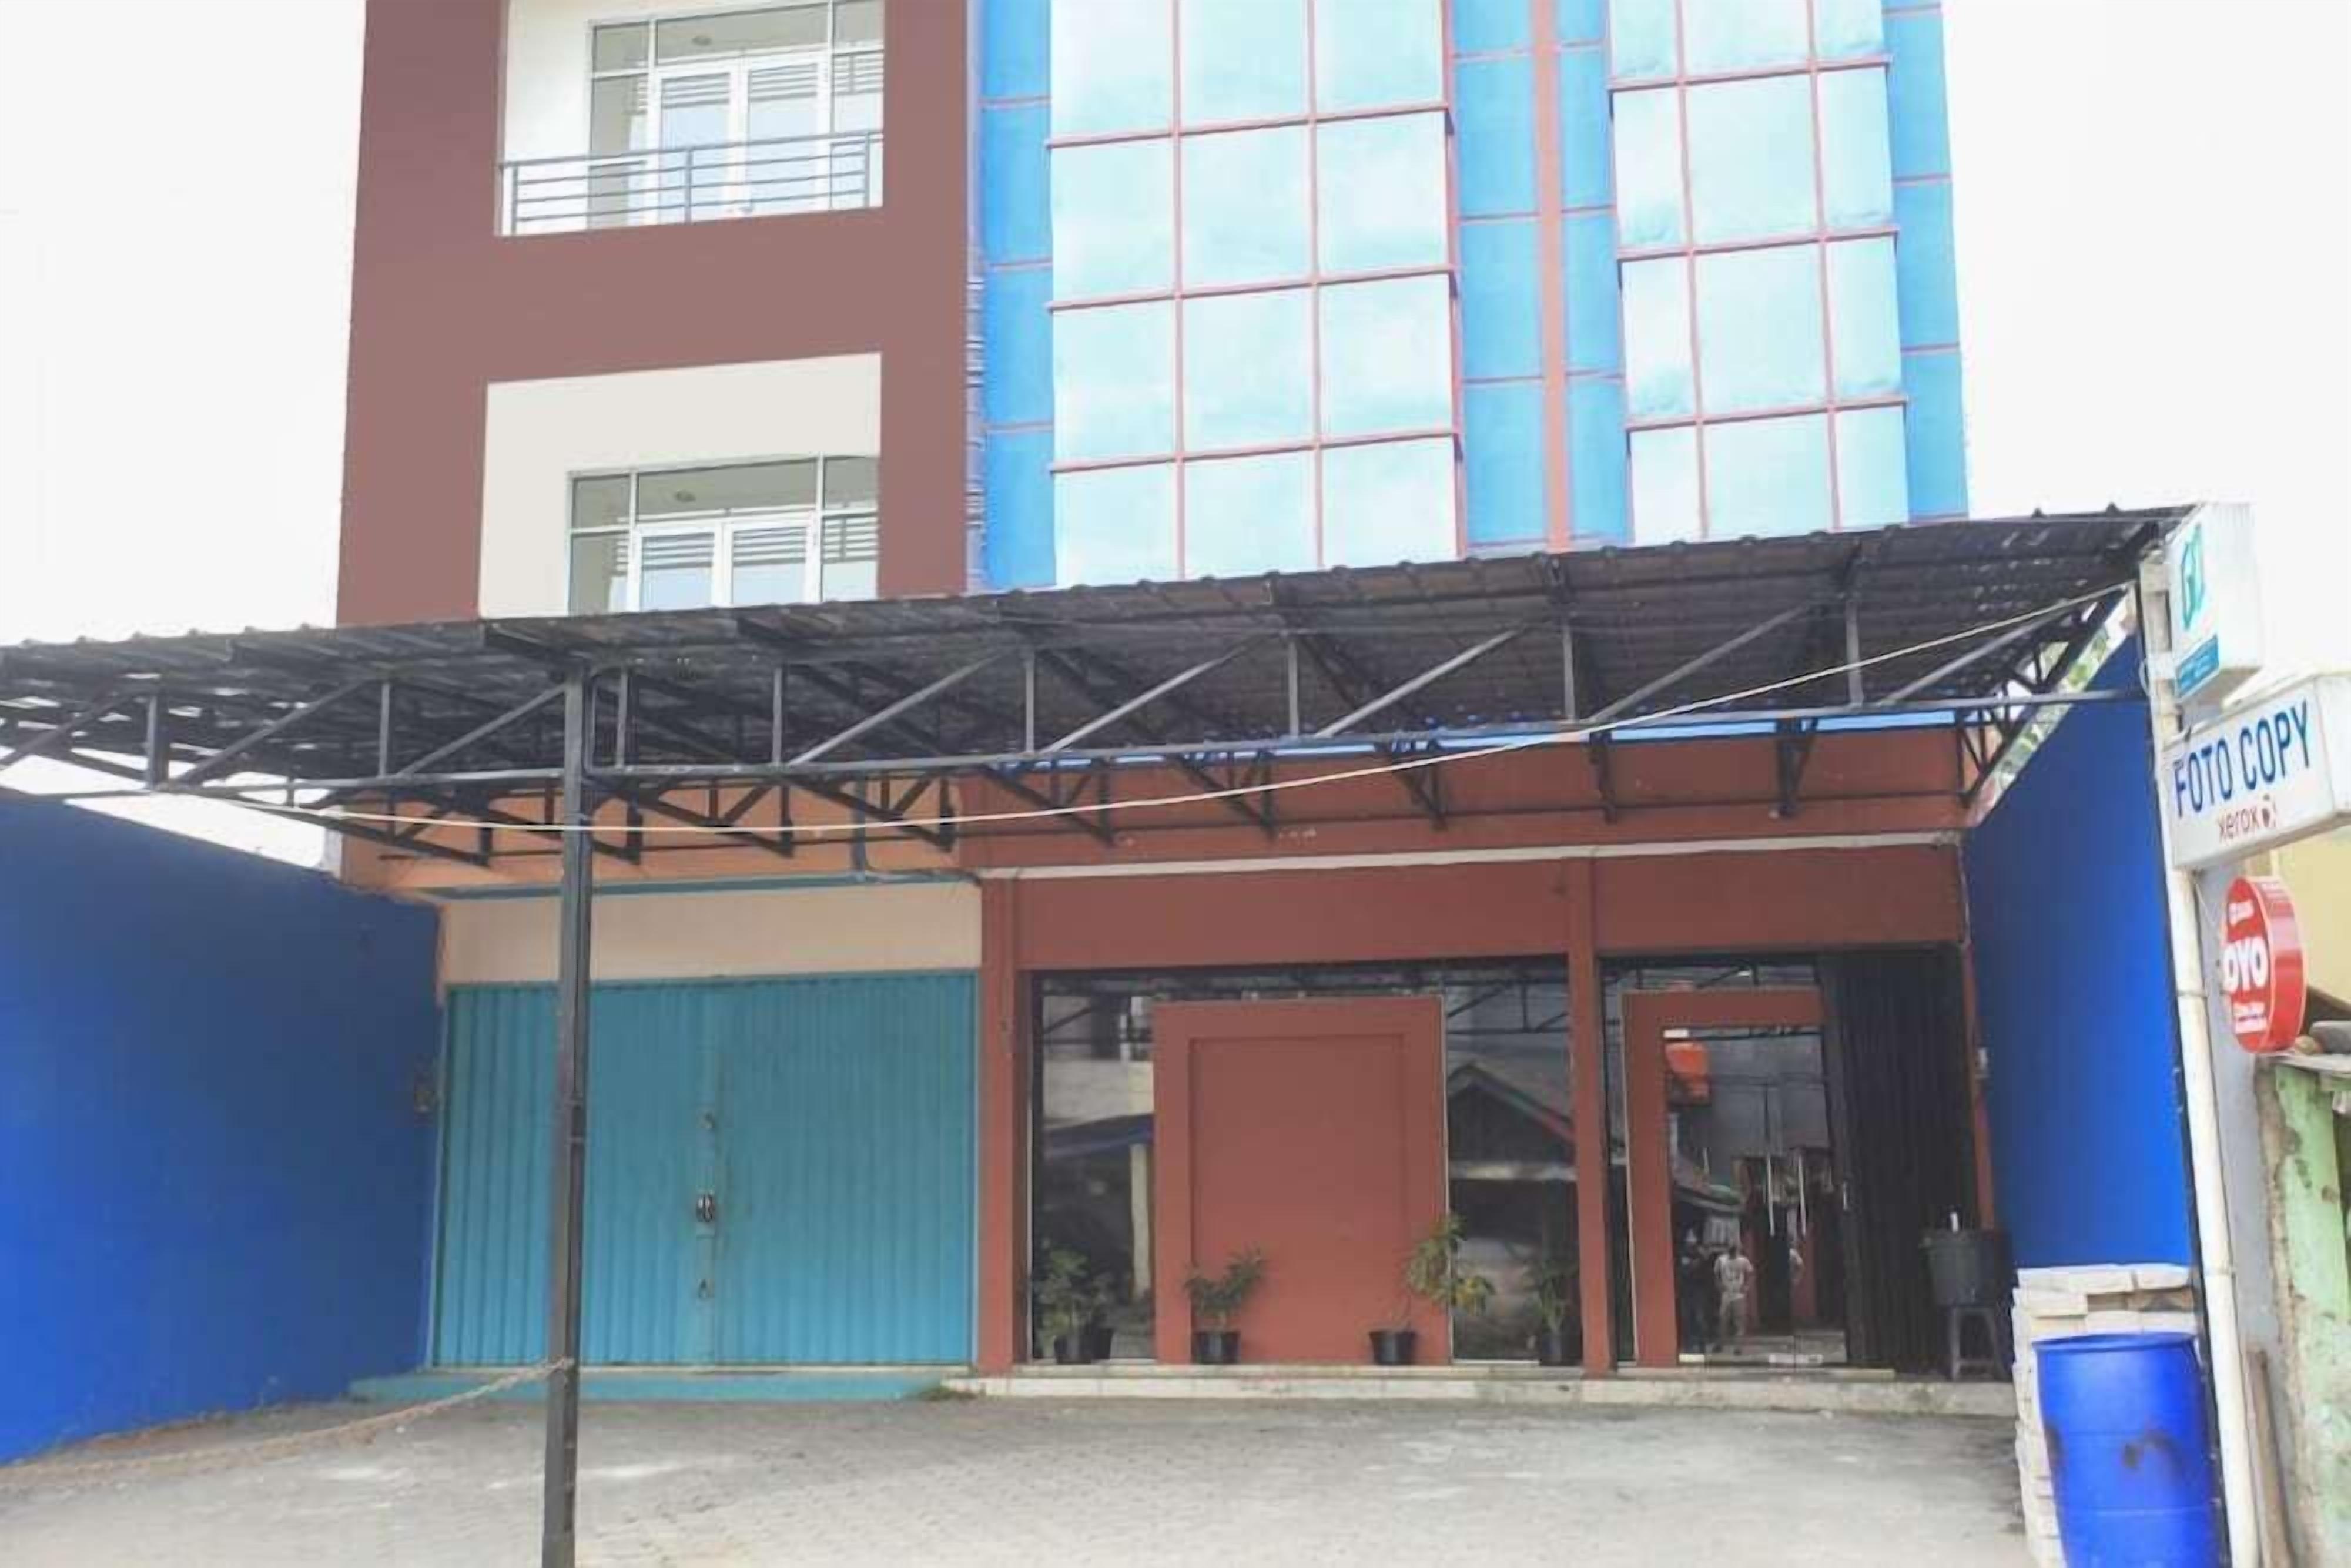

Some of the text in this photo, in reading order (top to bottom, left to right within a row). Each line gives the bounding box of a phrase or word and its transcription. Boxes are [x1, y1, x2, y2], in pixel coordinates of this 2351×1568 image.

[2173, 699, 2309, 817] FOTO COPY
[2219, 806, 2259, 842] xerox
[2223, 936, 2268, 991] OYO
